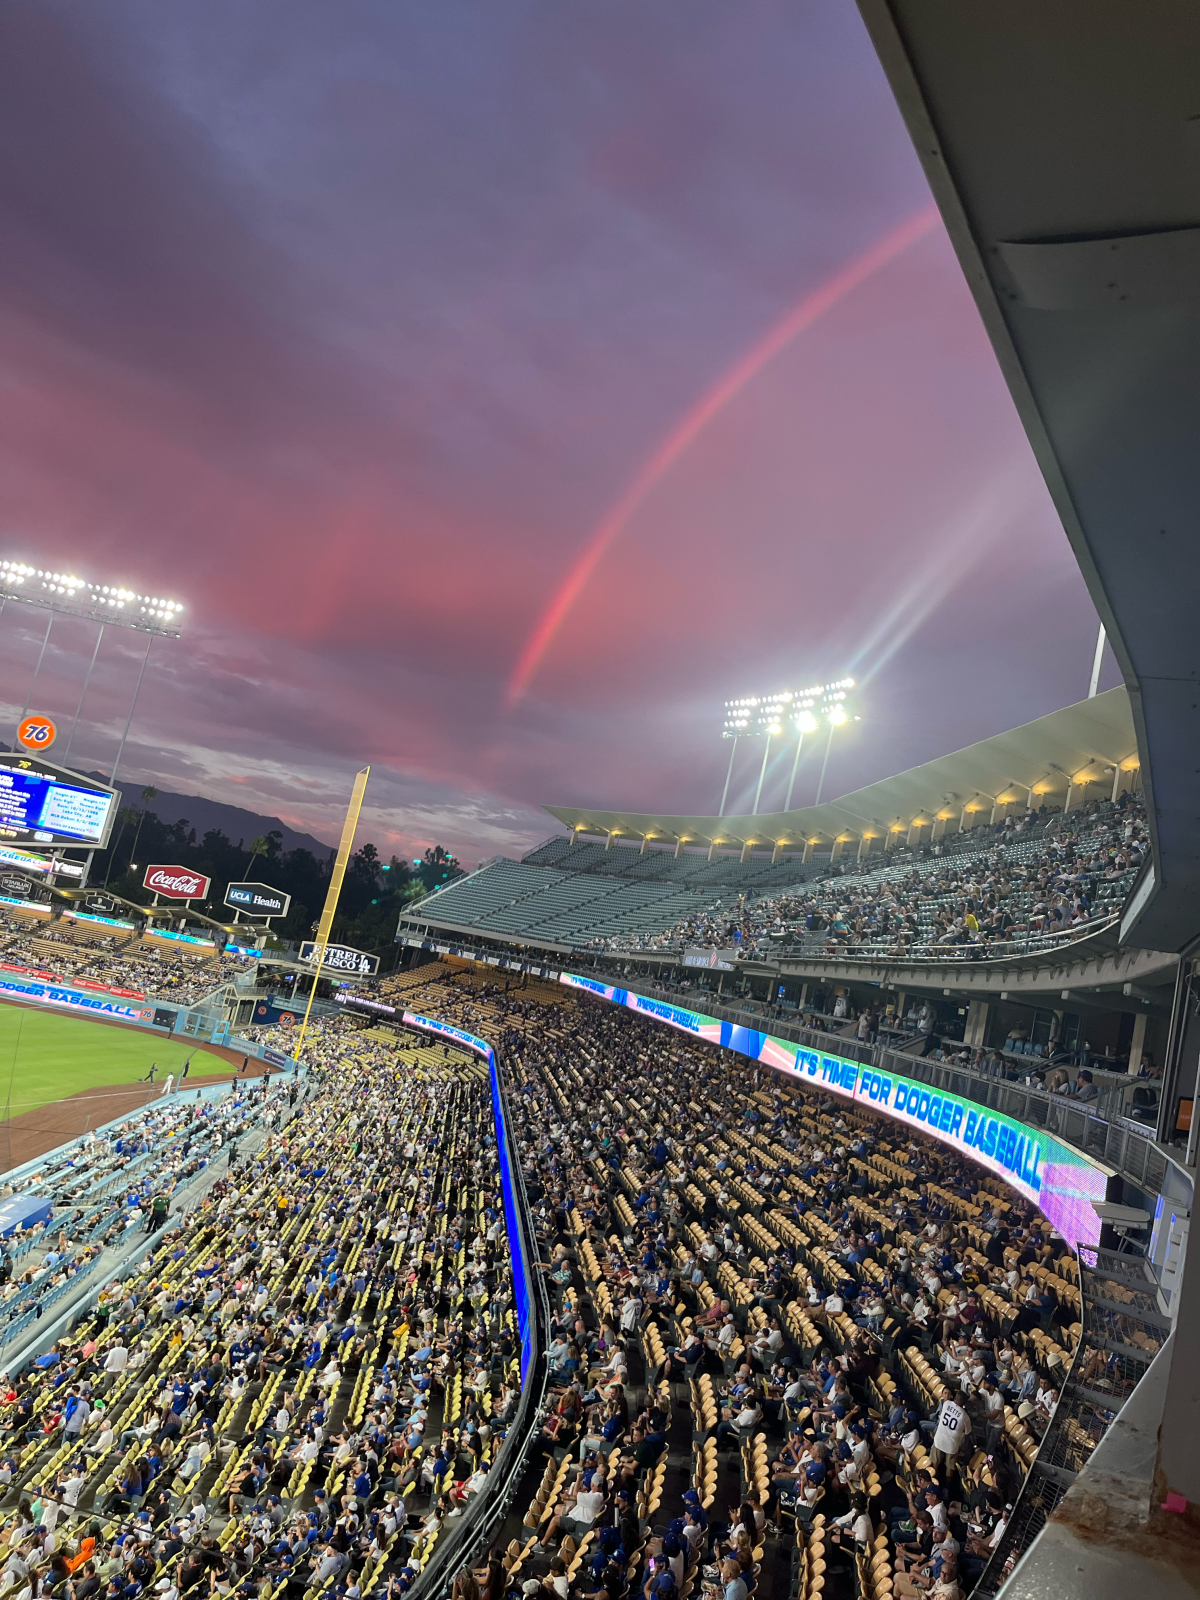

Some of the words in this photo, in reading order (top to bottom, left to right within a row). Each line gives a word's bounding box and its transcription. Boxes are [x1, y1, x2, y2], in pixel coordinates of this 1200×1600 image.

[23, 724, 50, 742] 76
[0, 851, 43, 865] ASEBALL
[4, 879, 30, 888] STARLUX
[149, 870, 202, 894] Coca-Cola
[230, 890, 250, 902] UCLA
[253, 894, 282, 909] Health
[305, 952, 356, 970] JALISCO
[65, 989, 84, 998] FOR
[48, 991, 136, 1018] BASEBALL
[142, 1010, 152, 1018] 76
[282, 1015, 292, 1024] 76
[672, 1008, 700, 1033] BASEBALL
[414, 1016, 427, 1025] IT'S
[429, 1020, 443, 1030] TIME
[443, 1025, 455, 1034] FOR
[454, 1030, 474, 1042] DODGER
[794, 1048, 820, 1076] IT'S
[822, 1056, 859, 1091] TIME
[859, 1069, 893, 1106] FOR
[893, 1080, 964, 1138] DODGER
[962, 1107, 1042, 1193] BASEBALL
[946, 1405, 962, 1419] BETTS
[942, 1412, 958, 1431] 50
